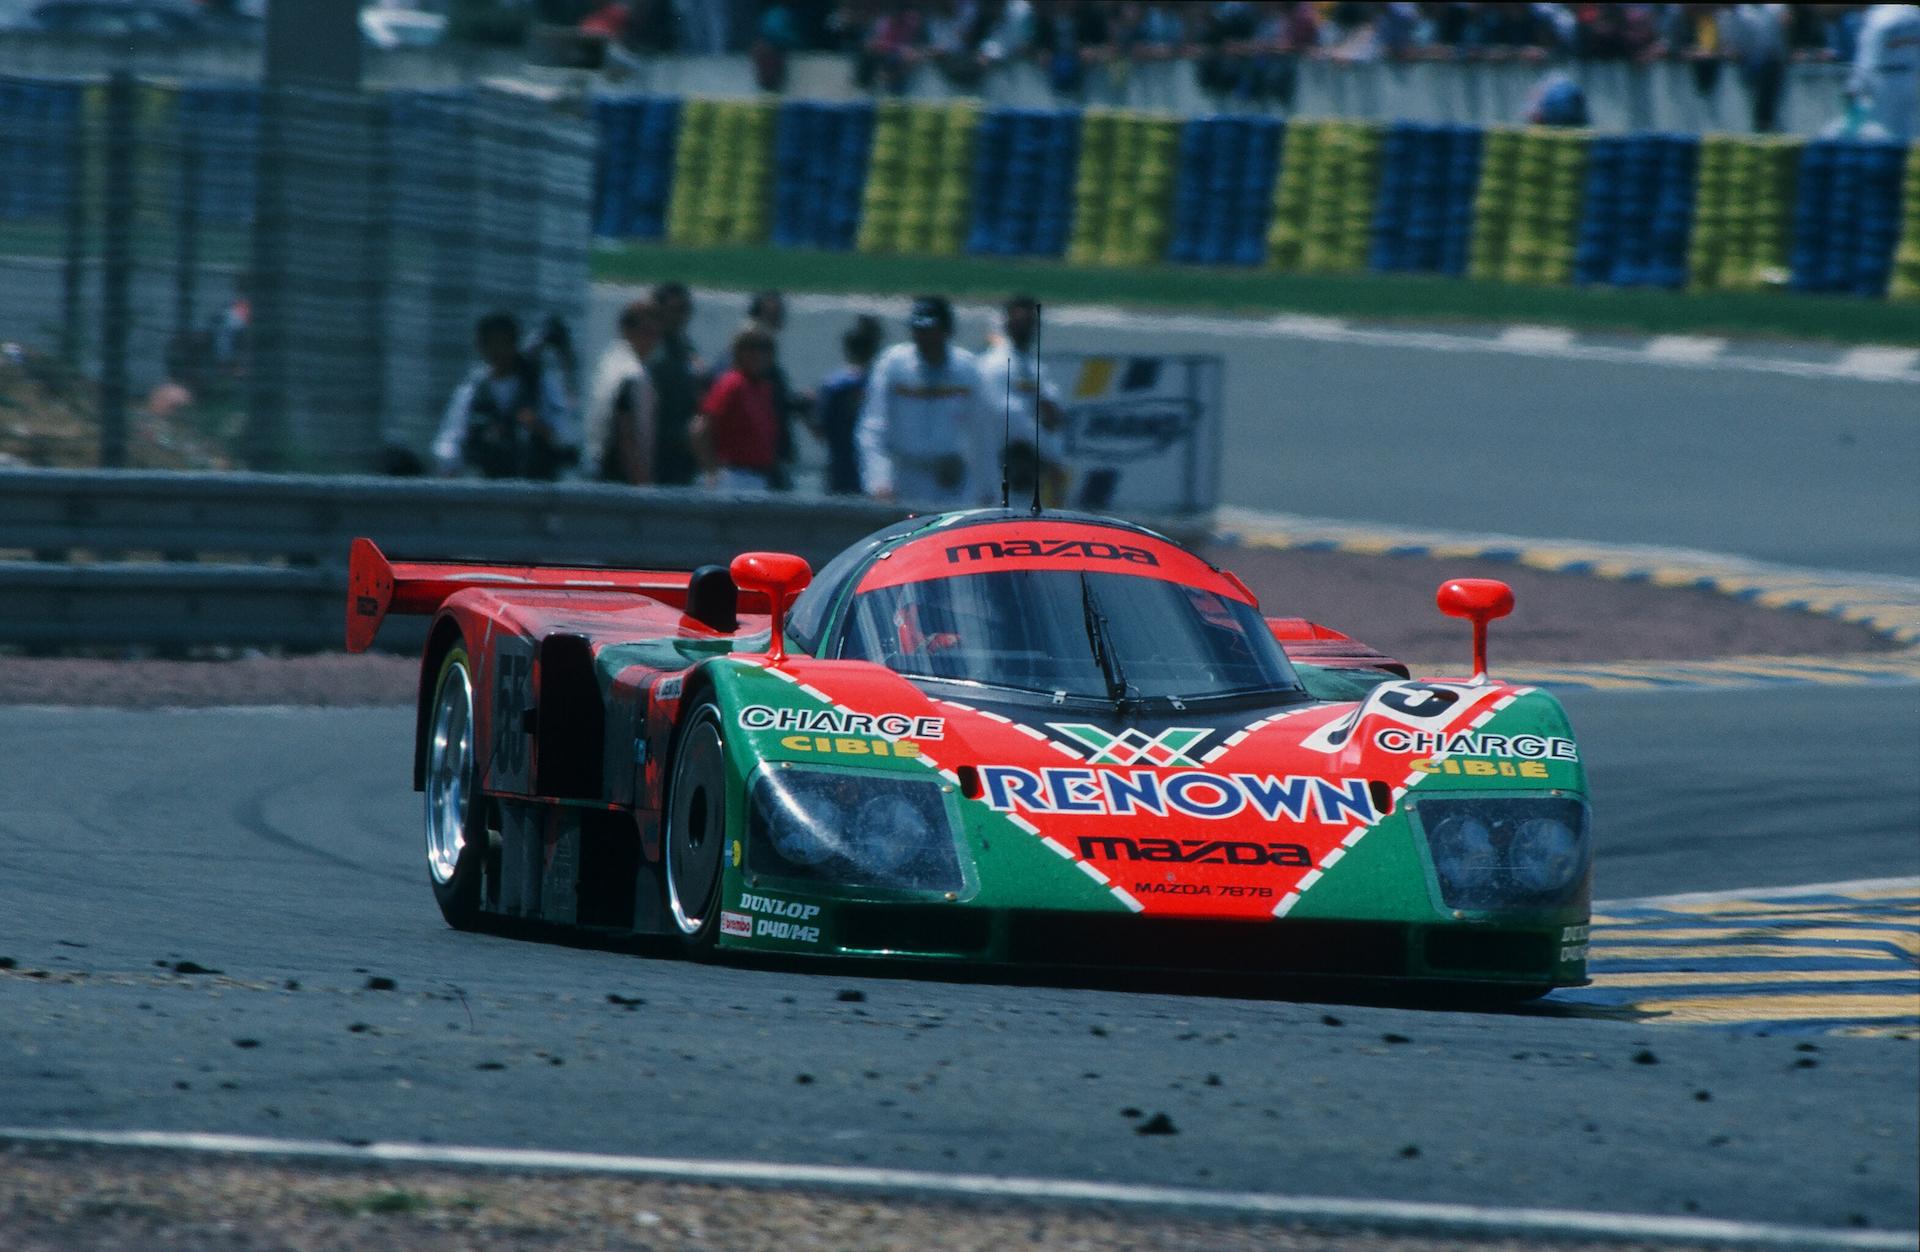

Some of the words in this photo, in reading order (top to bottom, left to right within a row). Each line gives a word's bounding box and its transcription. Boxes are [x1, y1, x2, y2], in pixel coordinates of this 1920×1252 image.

[945, 539, 1161, 567] mazda
[739, 704, 946, 740] CHARGE
[1375, 728, 1579, 762] CHARGE
[978, 765, 1380, 826] RENOWN
[1077, 835, 1313, 868] mazda
[1135, 882, 1213, 896] MAZDA
[739, 892, 821, 920] DUNLOP
